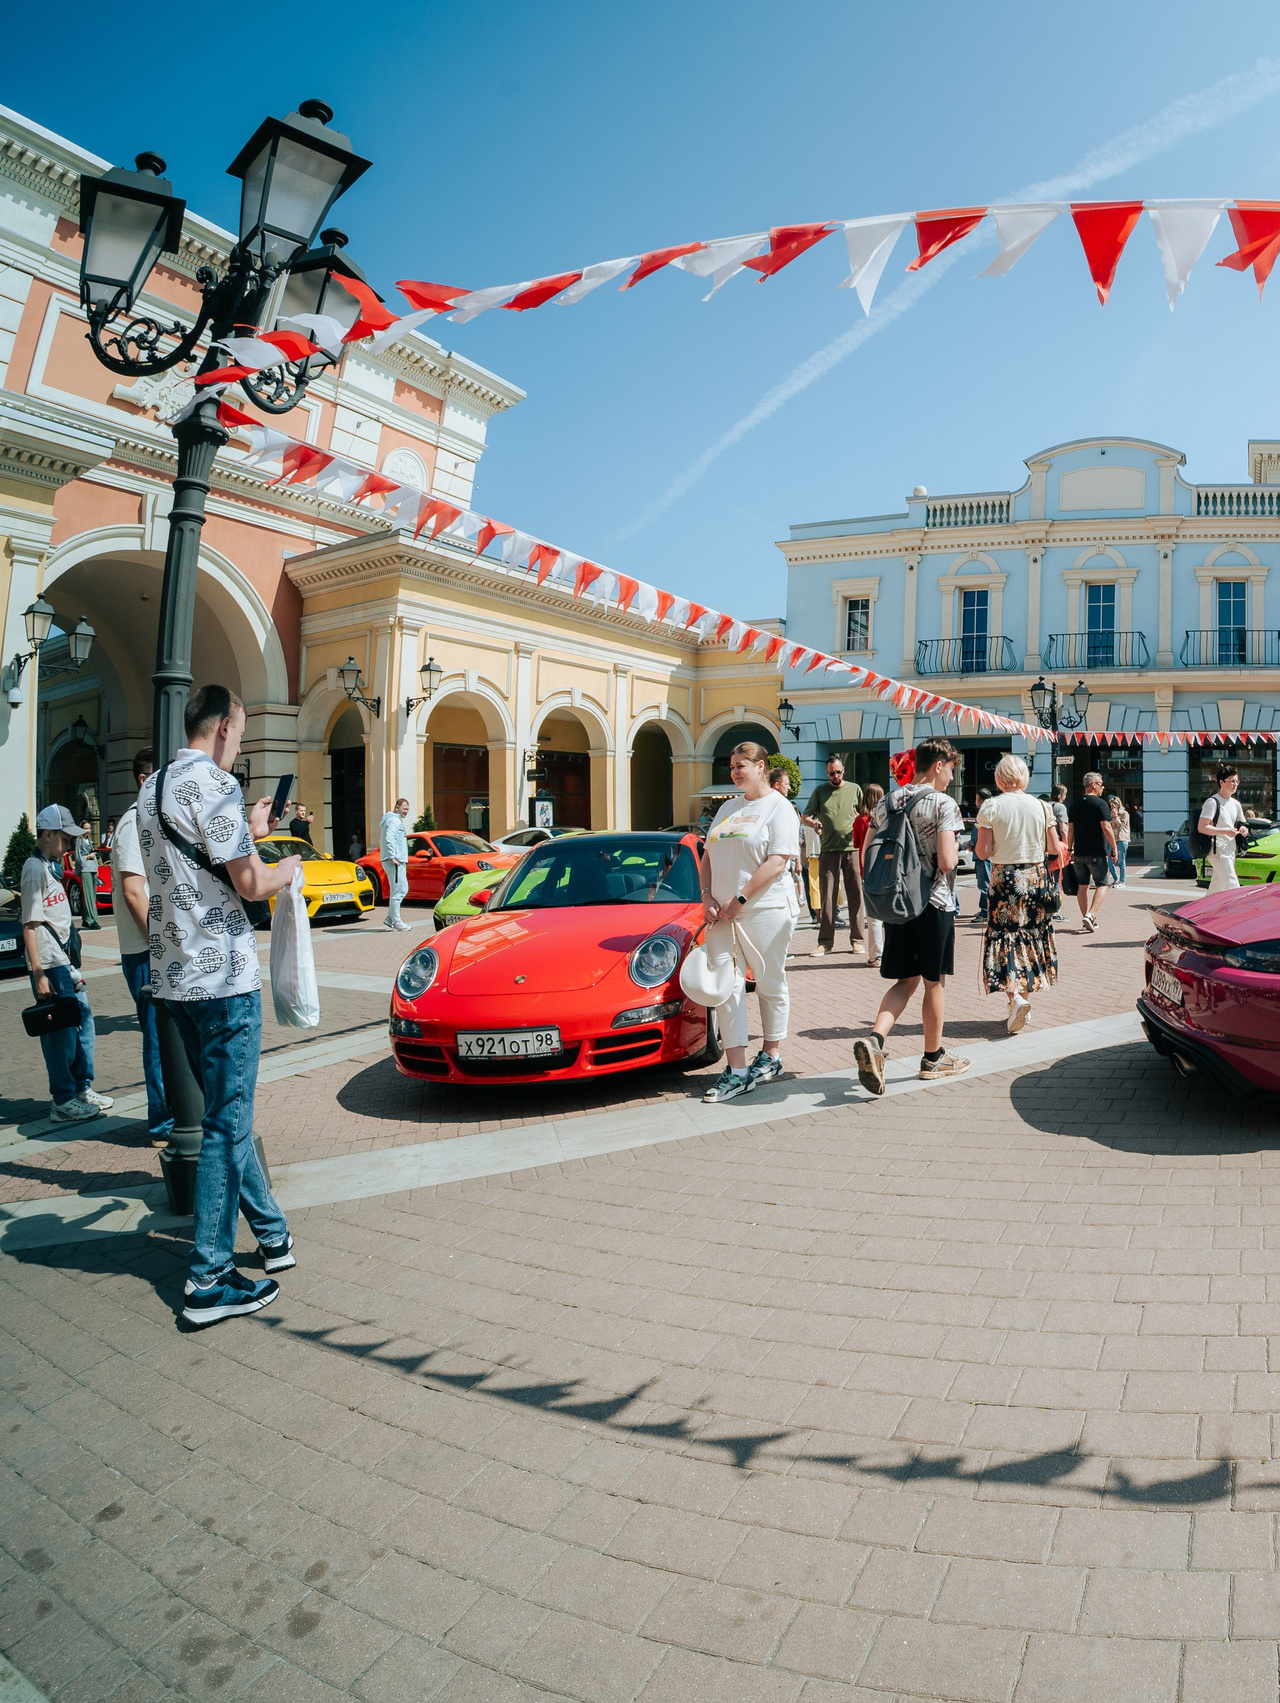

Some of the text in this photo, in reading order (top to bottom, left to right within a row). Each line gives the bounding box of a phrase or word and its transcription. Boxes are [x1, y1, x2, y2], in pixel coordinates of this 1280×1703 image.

[174, 787, 200, 800] LACOSTE
[206, 822, 235, 836] LACOSTE
[172, 893, 199, 901] LACOSTE
[226, 919, 246, 927] ACOSTE
[195, 956, 223, 964] LACOSTE
[230, 958, 246, 967] OSTE
[535, 1033, 553, 1047] 98
